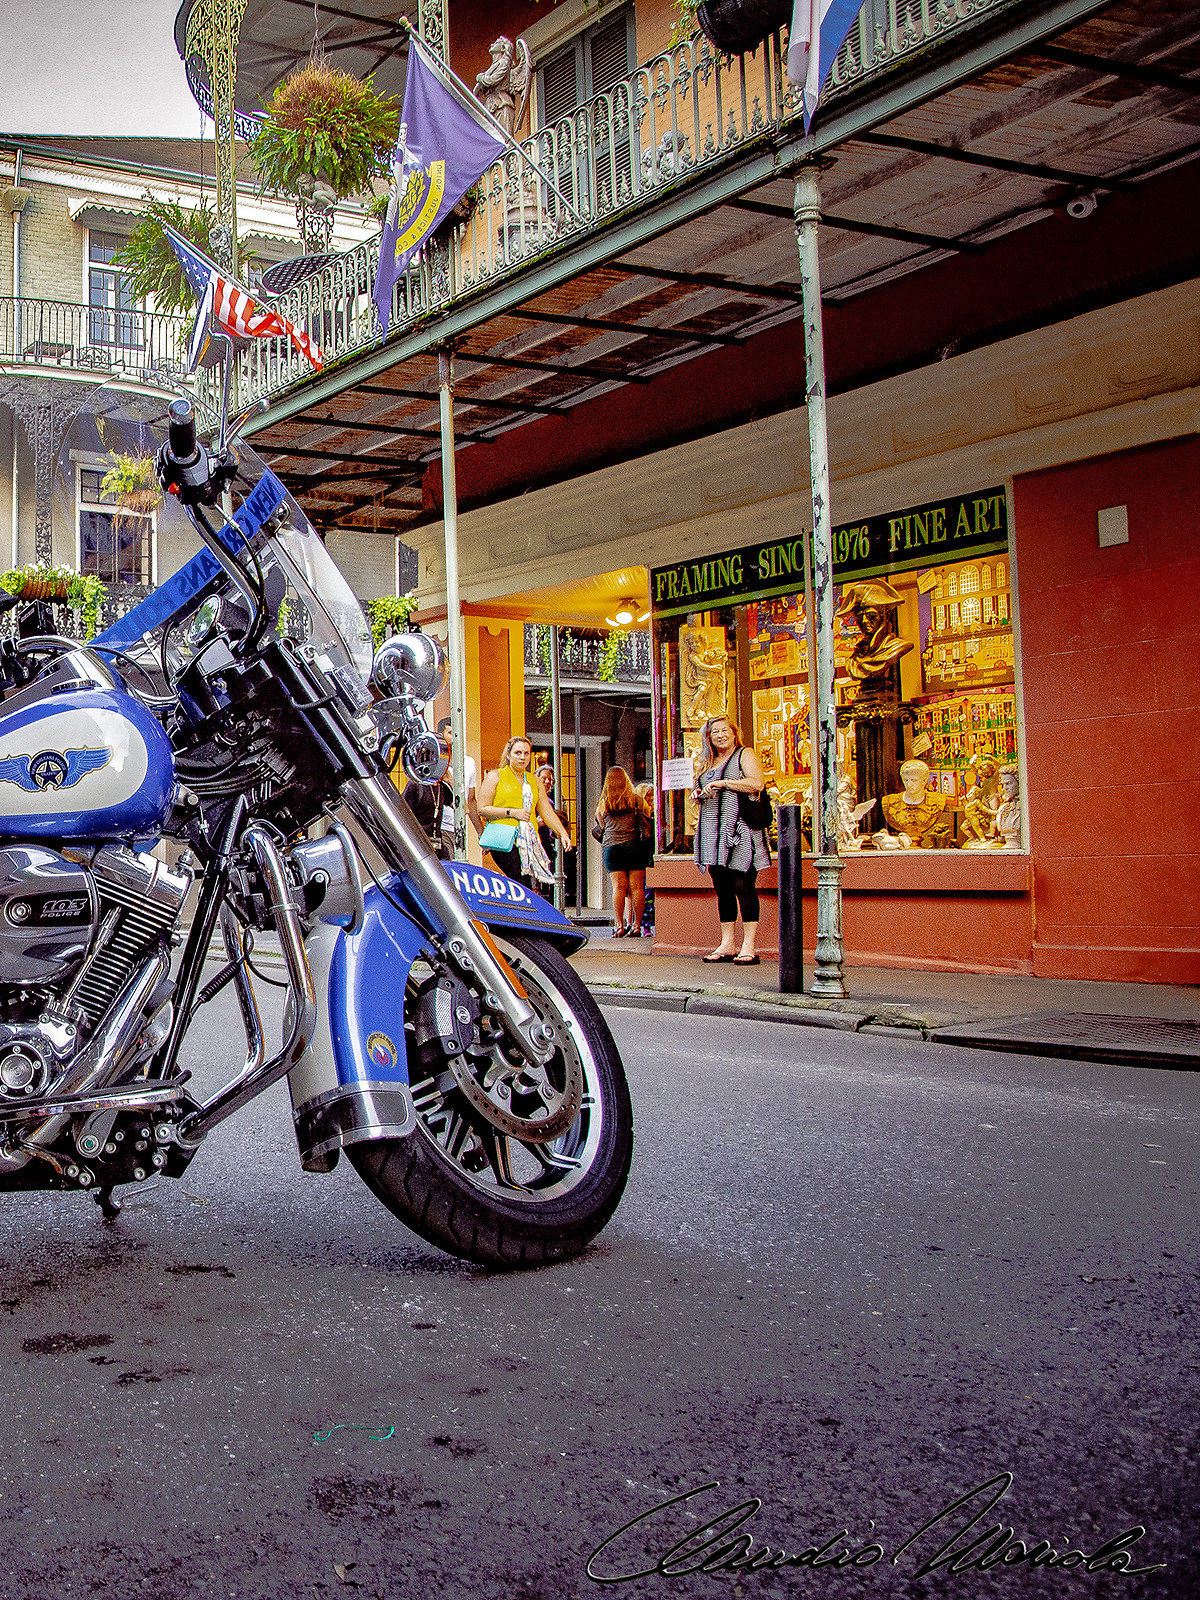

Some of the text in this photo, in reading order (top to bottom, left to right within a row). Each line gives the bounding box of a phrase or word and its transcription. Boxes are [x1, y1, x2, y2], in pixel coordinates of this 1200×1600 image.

[655, 554, 744, 602] FRAMING
[832, 525, 870, 564] 1976
[888, 507, 947, 553] FINE
[953, 494, 1006, 539] ART
[451, 868, 532, 904] N.O.P.D.
